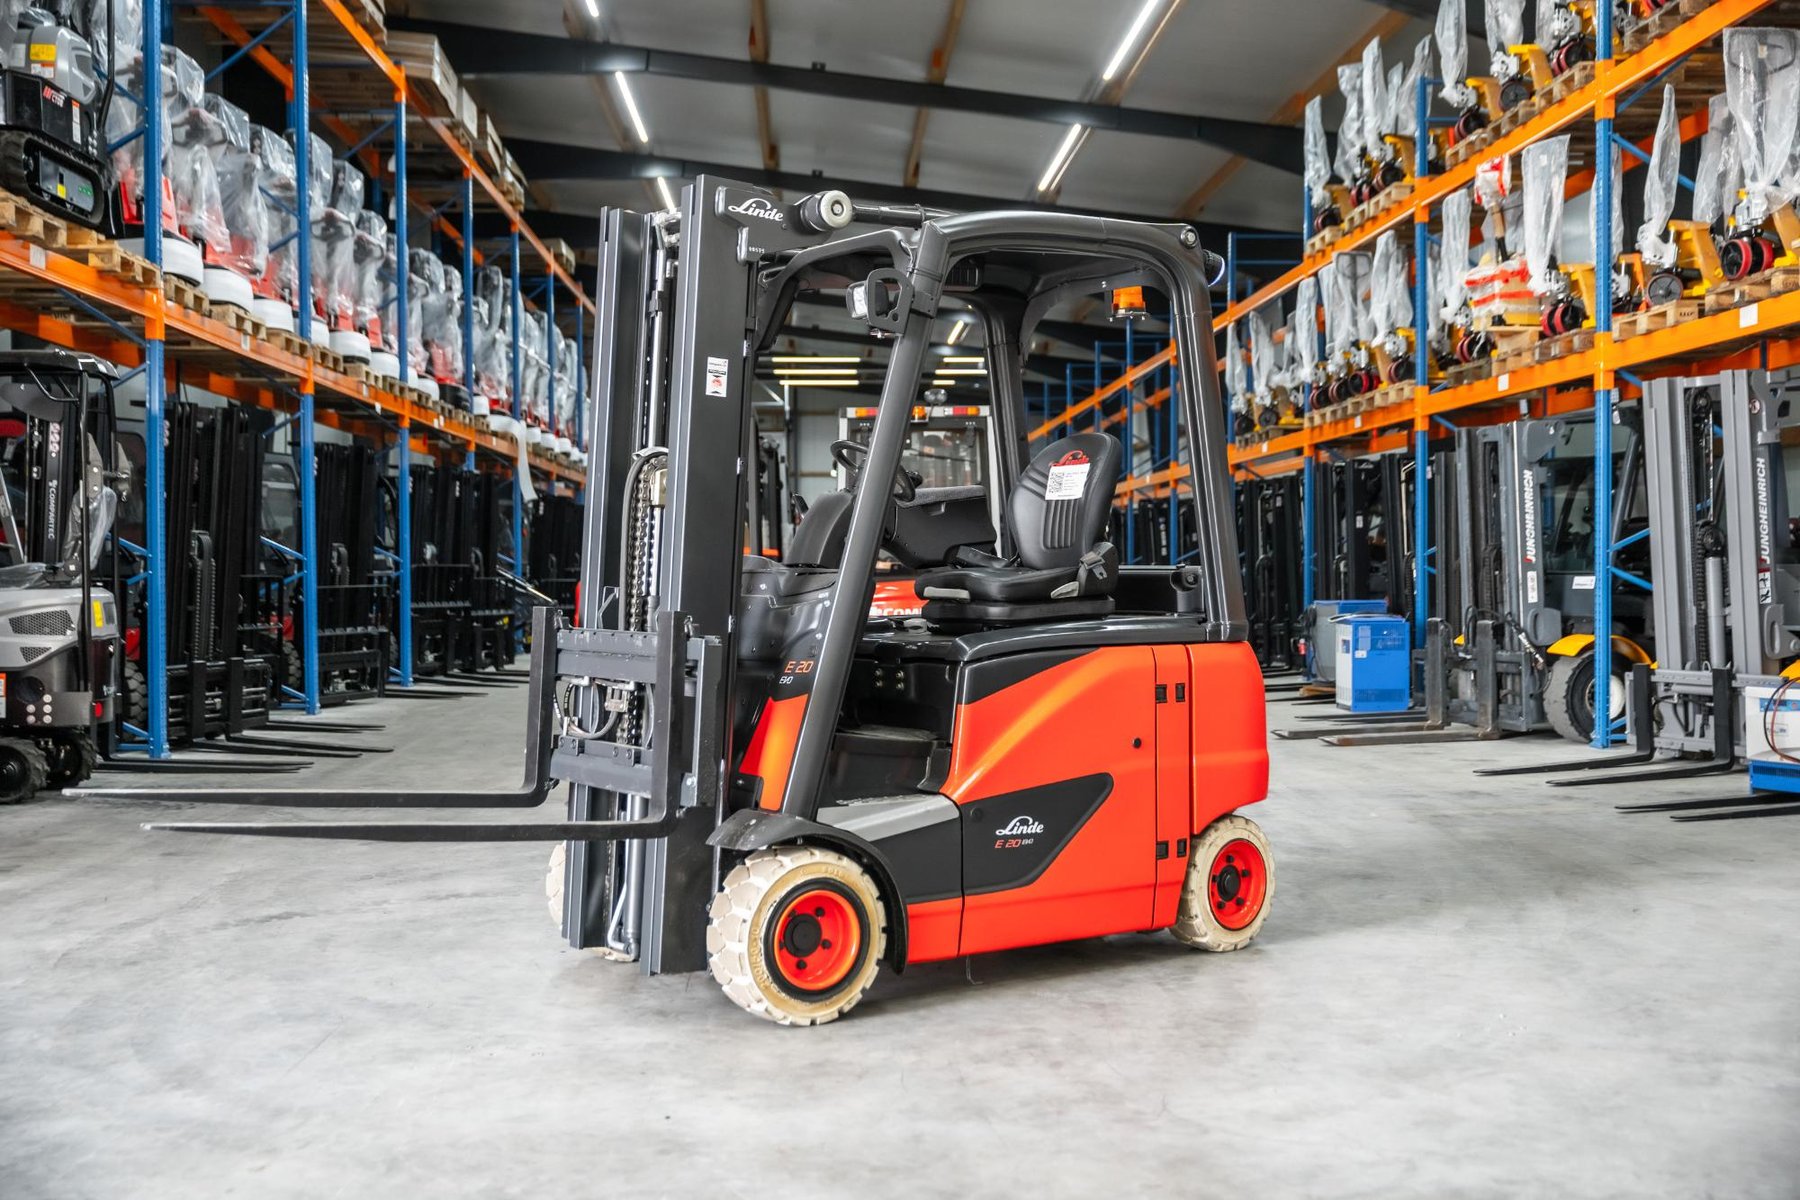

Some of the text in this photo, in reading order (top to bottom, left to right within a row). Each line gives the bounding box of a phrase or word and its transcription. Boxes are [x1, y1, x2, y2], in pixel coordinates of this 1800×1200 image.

[728, 198, 783, 221] Linde
[1522, 469, 1537, 564] JUNGHEINRICH
[1756, 457, 1771, 565] JUNGHEINRICH
[784, 660, 814, 673] E 20
[995, 815, 1044, 836] Linde
[994, 839, 1005, 849] E
[1005, 839, 1021, 848] 20
